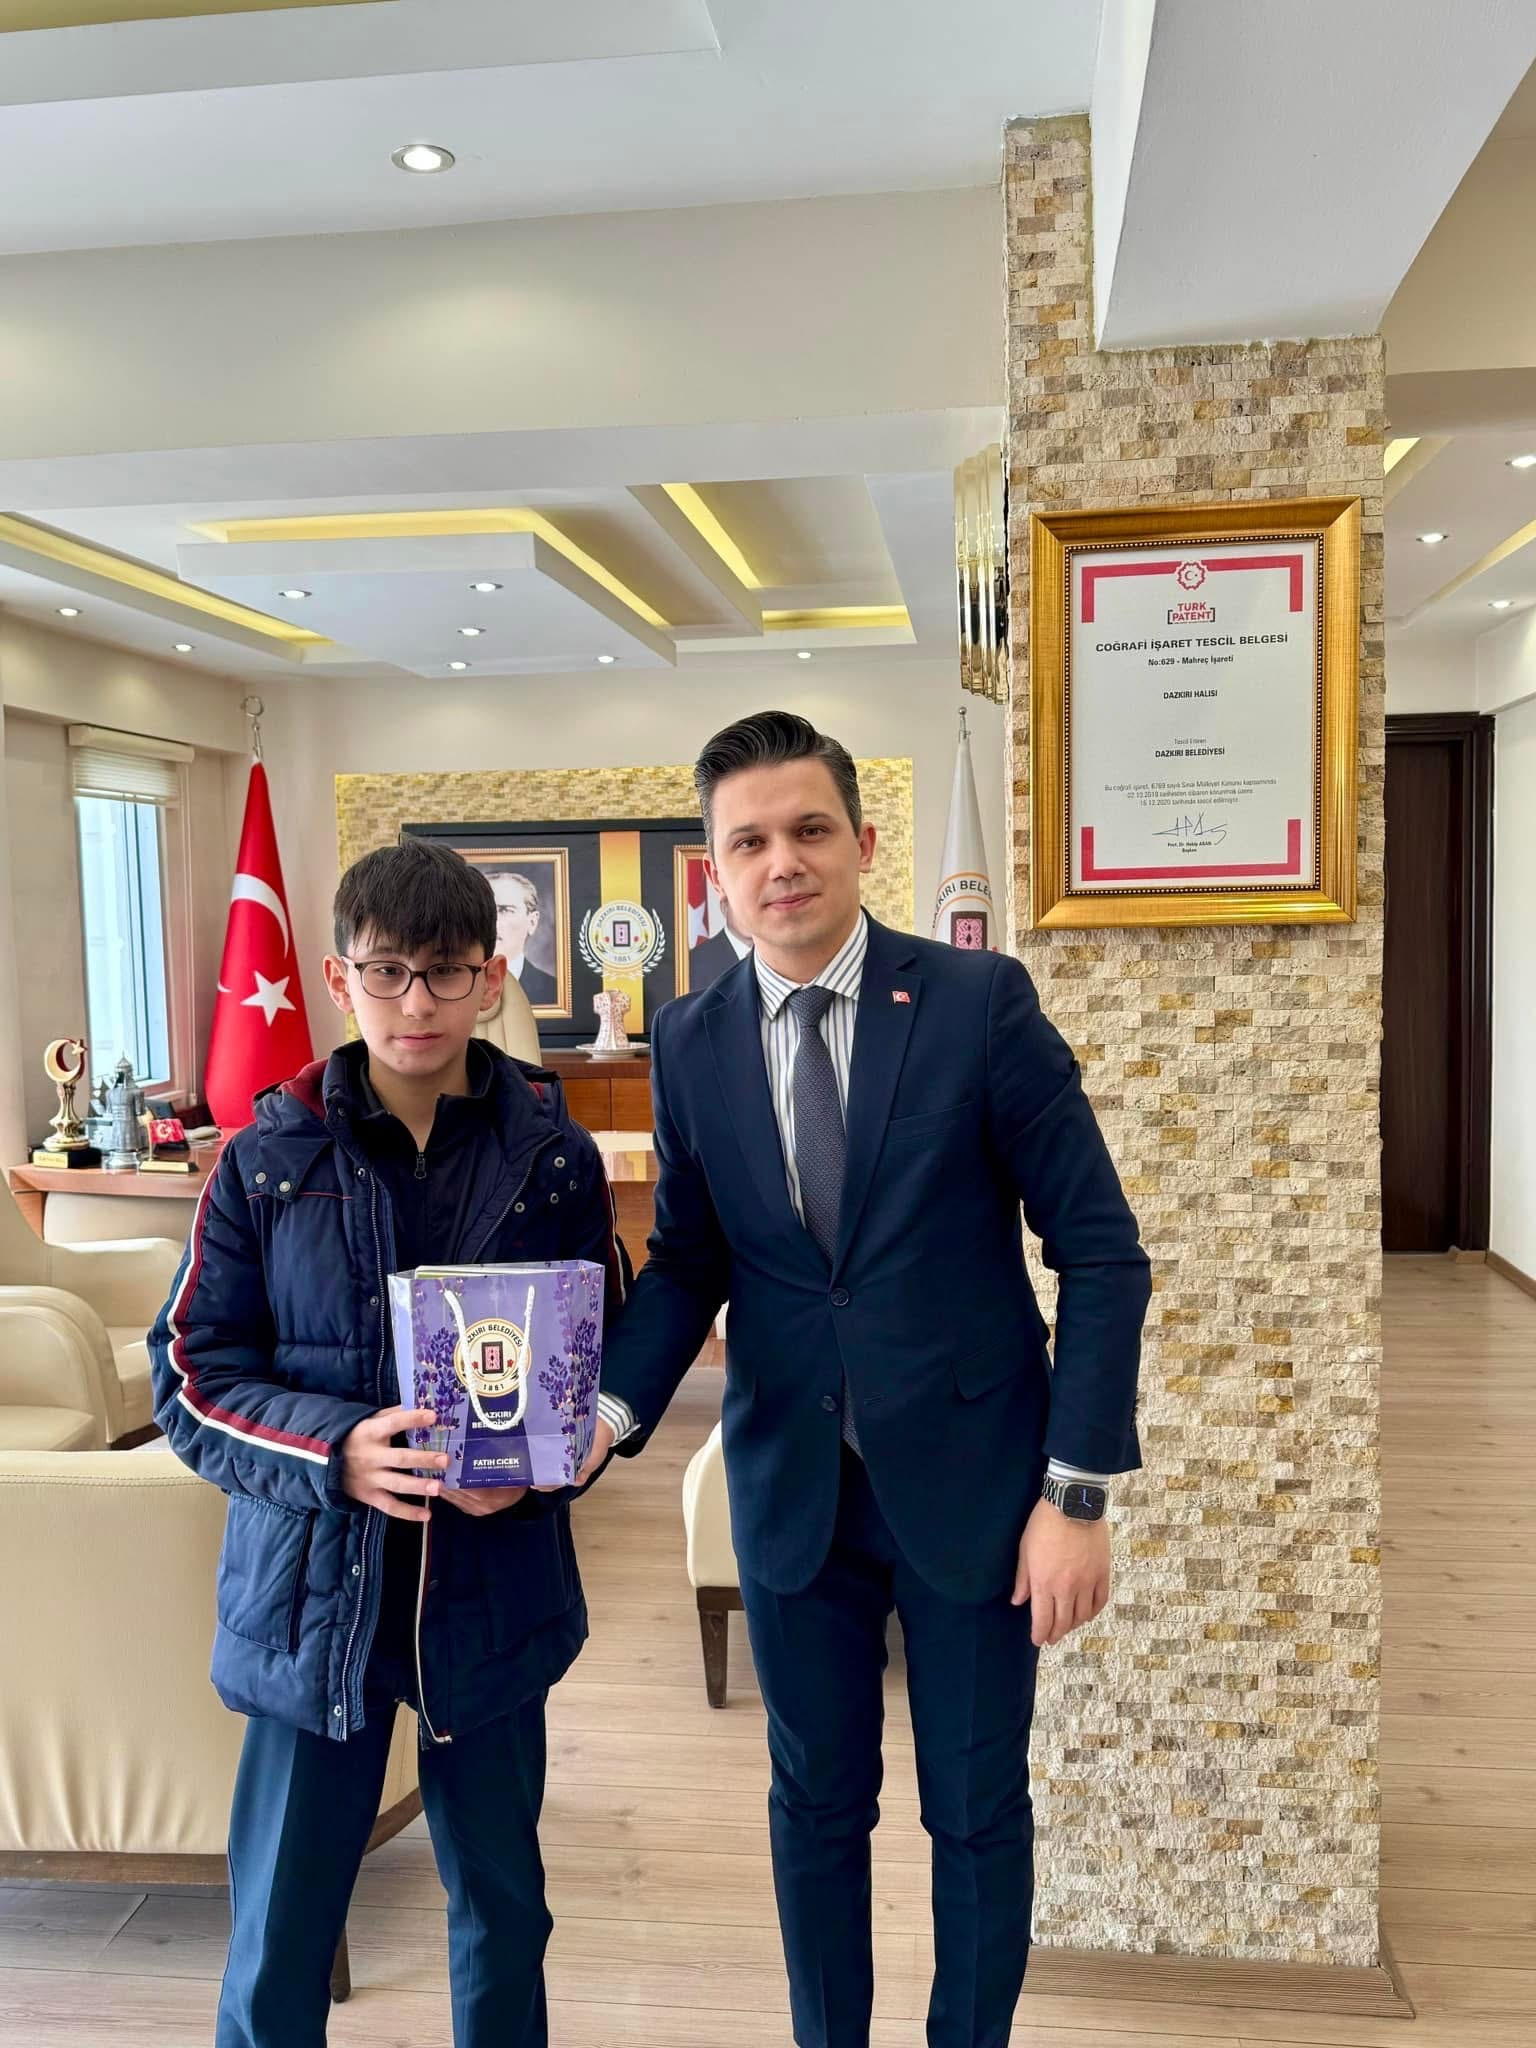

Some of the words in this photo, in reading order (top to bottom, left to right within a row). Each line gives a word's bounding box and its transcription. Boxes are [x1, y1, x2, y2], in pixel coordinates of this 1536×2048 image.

[1171, 611, 1212, 622] PATENT
[1096, 641, 1148, 652] COĞRAFİ
[1151, 638, 1192, 652] İŞARET
[1196, 636, 1236, 648] TESCİL
[1239, 633, 1289, 646] BELGESİ
[1181, 656, 1209, 665] Mahreç
[1163, 690, 1193, 700] DAZKIRI
[1194, 689, 1218, 699] HALISI
[1155, 748, 1184, 758] DAZKIRI
[1185, 746, 1225, 757] BELEDİYESİ
[484, 1410, 512, 1419] AZKIRI
